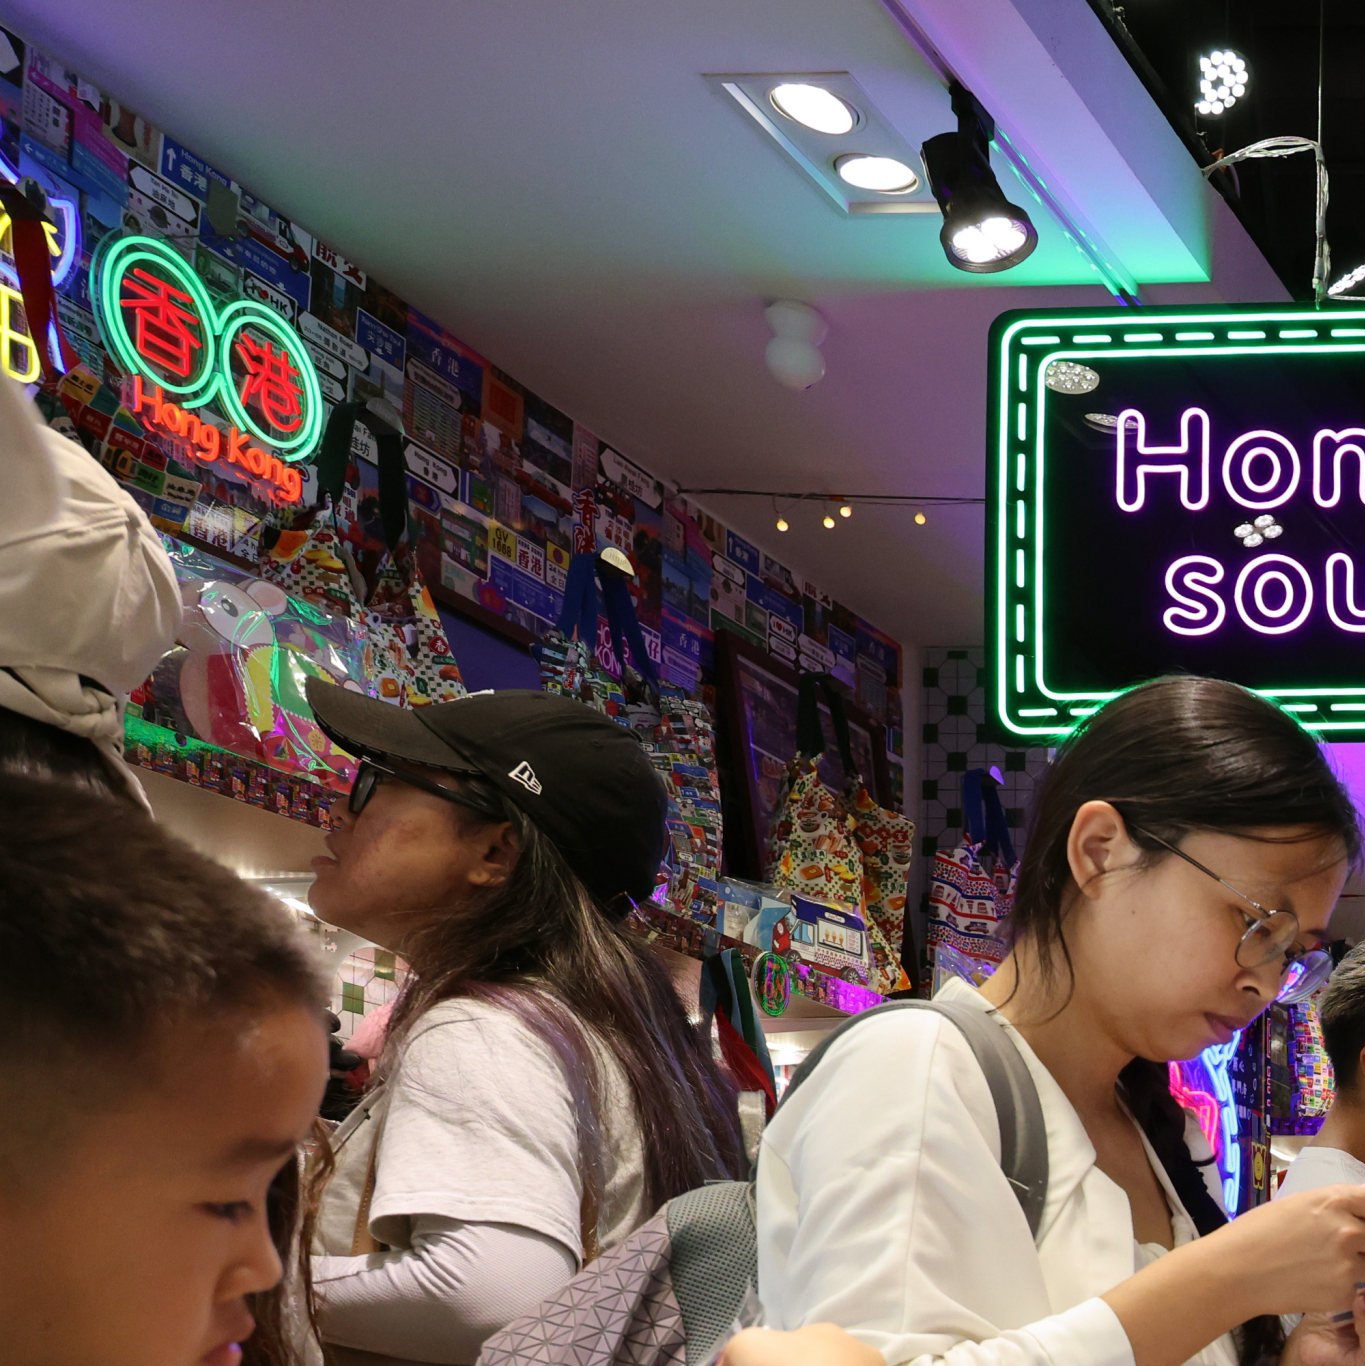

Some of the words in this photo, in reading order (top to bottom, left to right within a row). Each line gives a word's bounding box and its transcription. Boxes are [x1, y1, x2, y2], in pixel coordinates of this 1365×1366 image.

[119, 266, 304, 434] 香港
[133, 374, 220, 462] Hong
[227, 426, 302, 502] Kong
